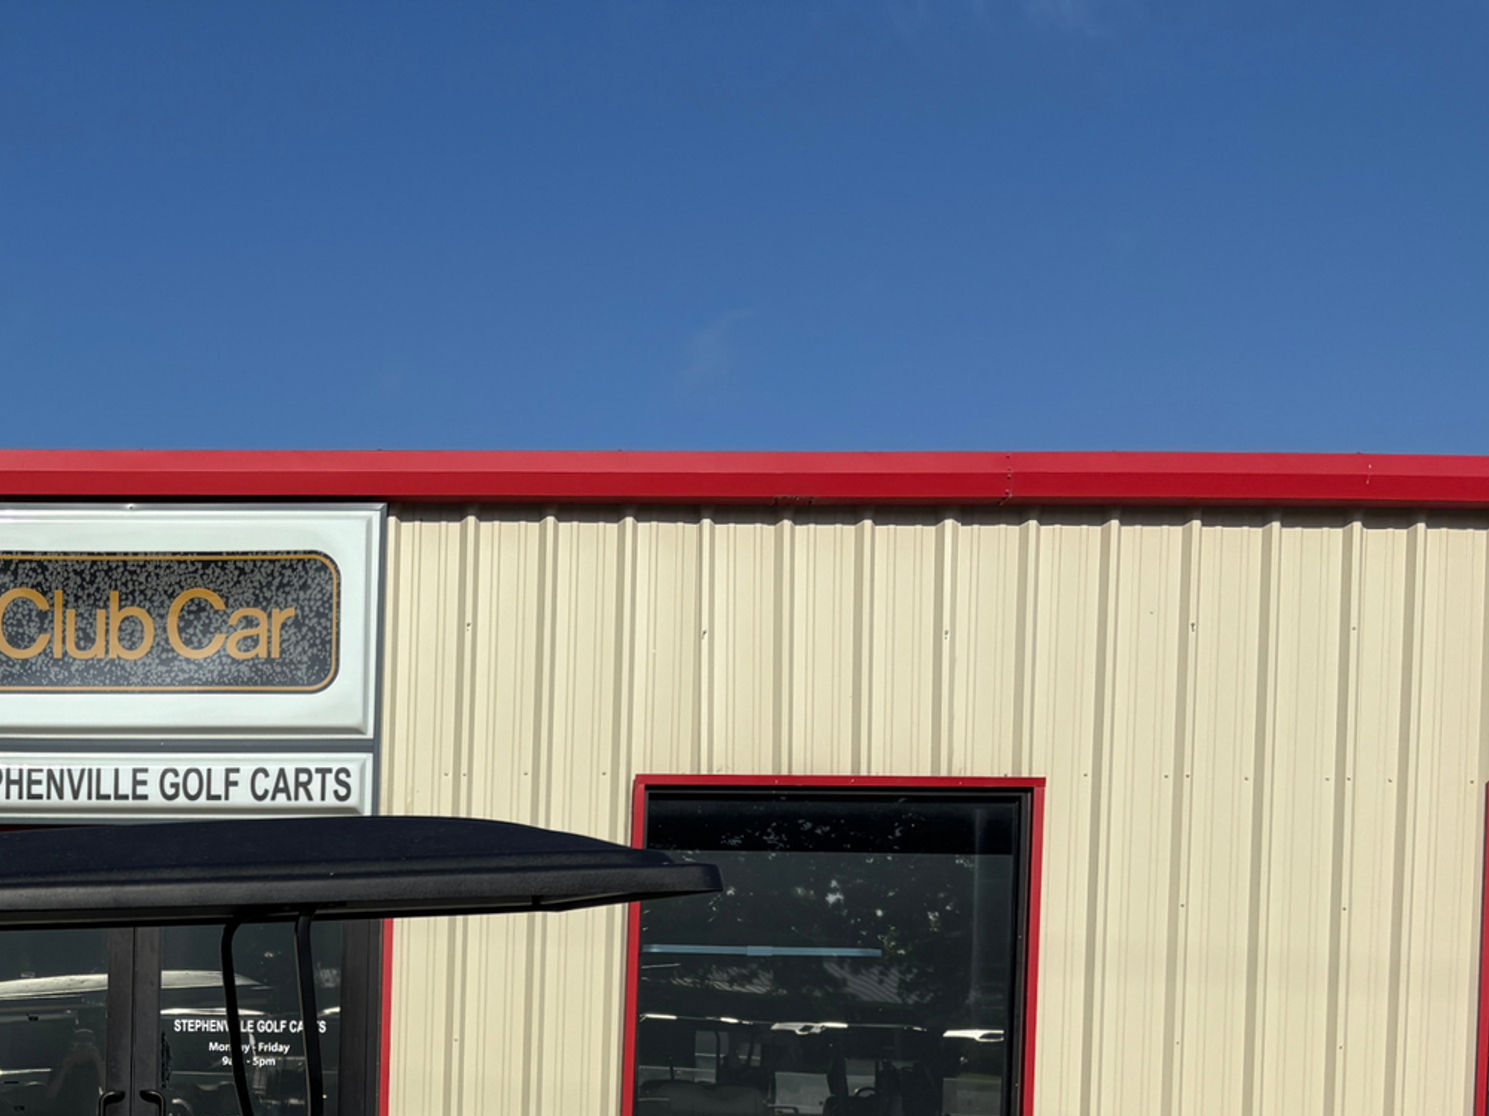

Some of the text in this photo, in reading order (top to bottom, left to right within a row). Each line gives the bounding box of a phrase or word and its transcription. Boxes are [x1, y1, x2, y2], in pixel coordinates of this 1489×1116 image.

[166, 587, 295, 660] Car
[159, 766, 240, 801] GOLF
[249, 767, 353, 802] CARTS
[173, 1019, 327, 1034] STEPHENVLE GOLF CAS
[208, 1042, 250, 1054] Mony
[258, 1042, 290, 1055] Friday
[252, 1057, 276, 1067] 5pm
